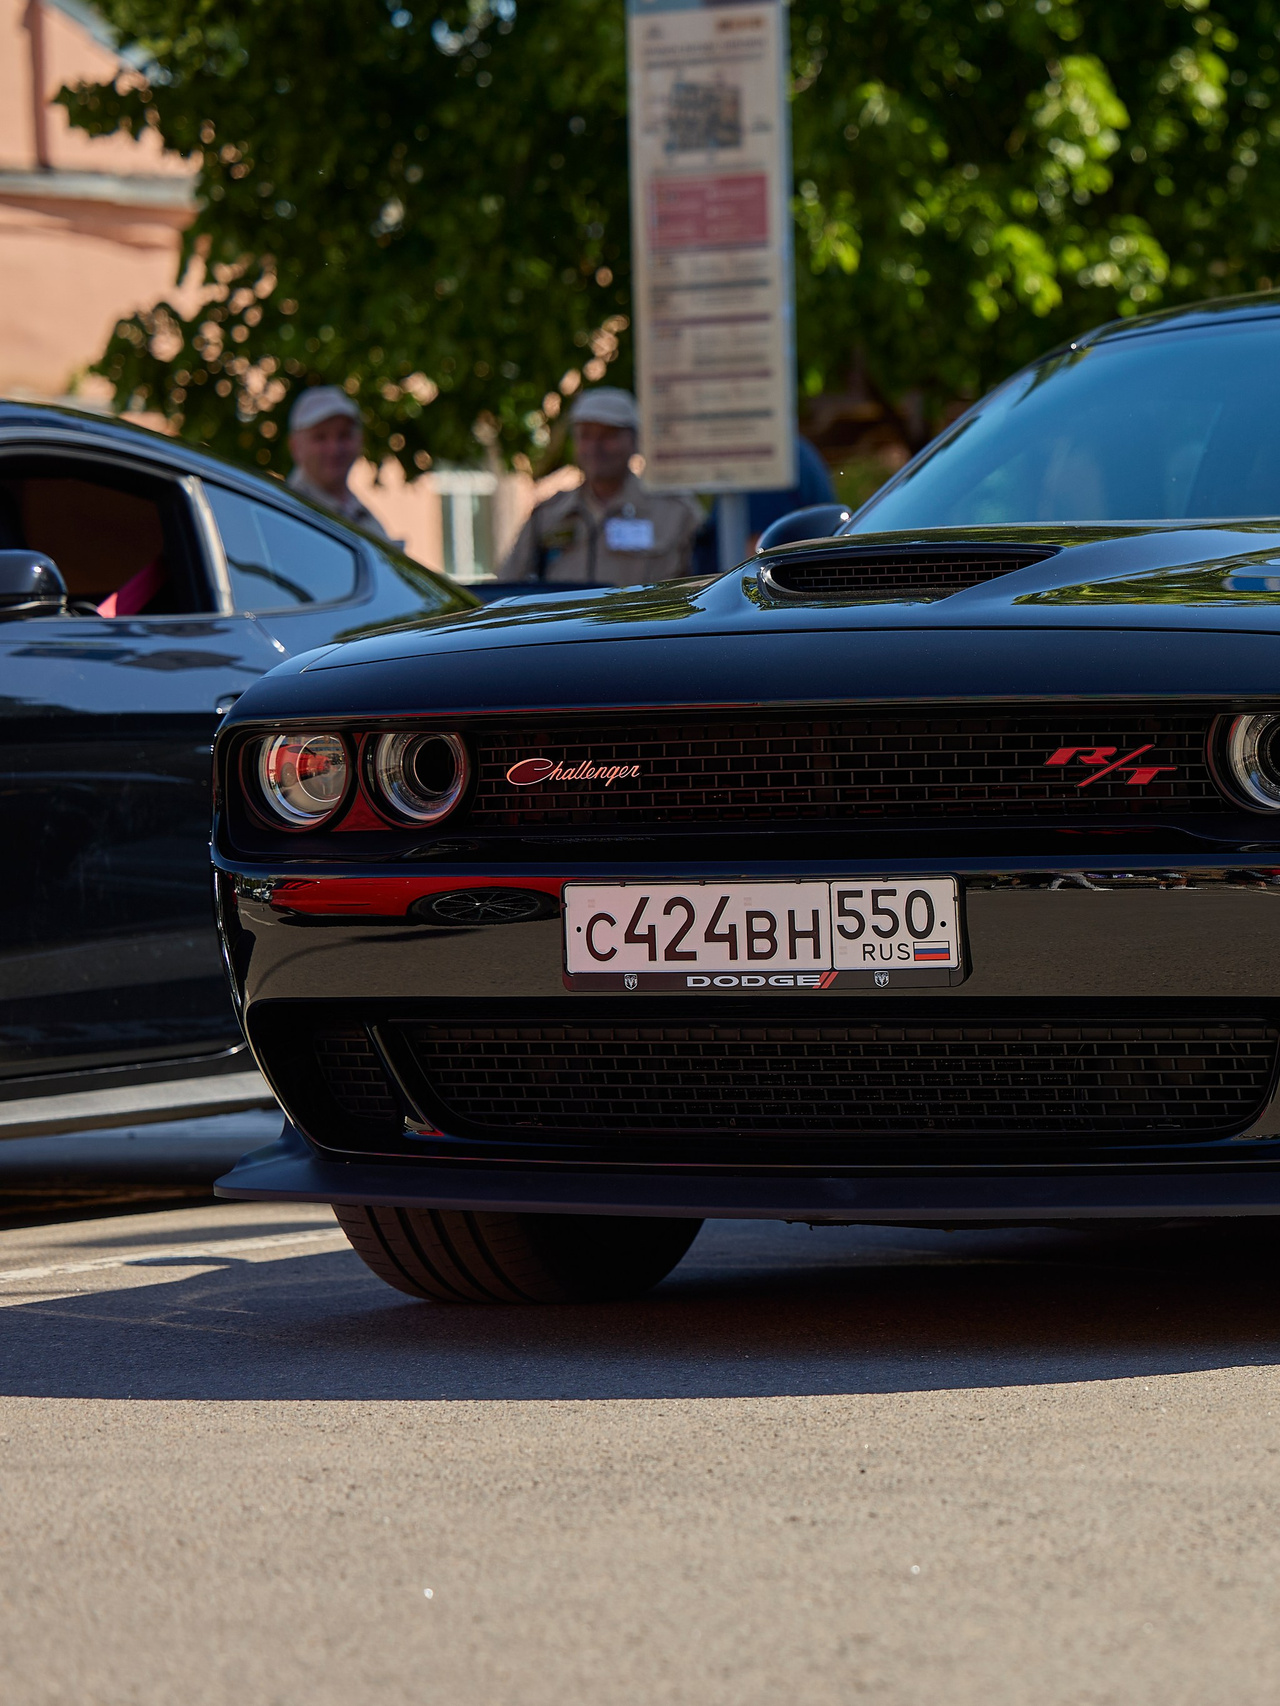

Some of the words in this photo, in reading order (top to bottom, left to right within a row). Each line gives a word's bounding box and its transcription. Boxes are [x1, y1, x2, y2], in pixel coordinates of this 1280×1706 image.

[506, 757, 641, 787] Challenger
[1043, 744, 1178, 787] R/T
[836, 888, 935, 940] 550
[862, 943, 911, 960] RUS
[686, 974, 820, 988] DODGE
